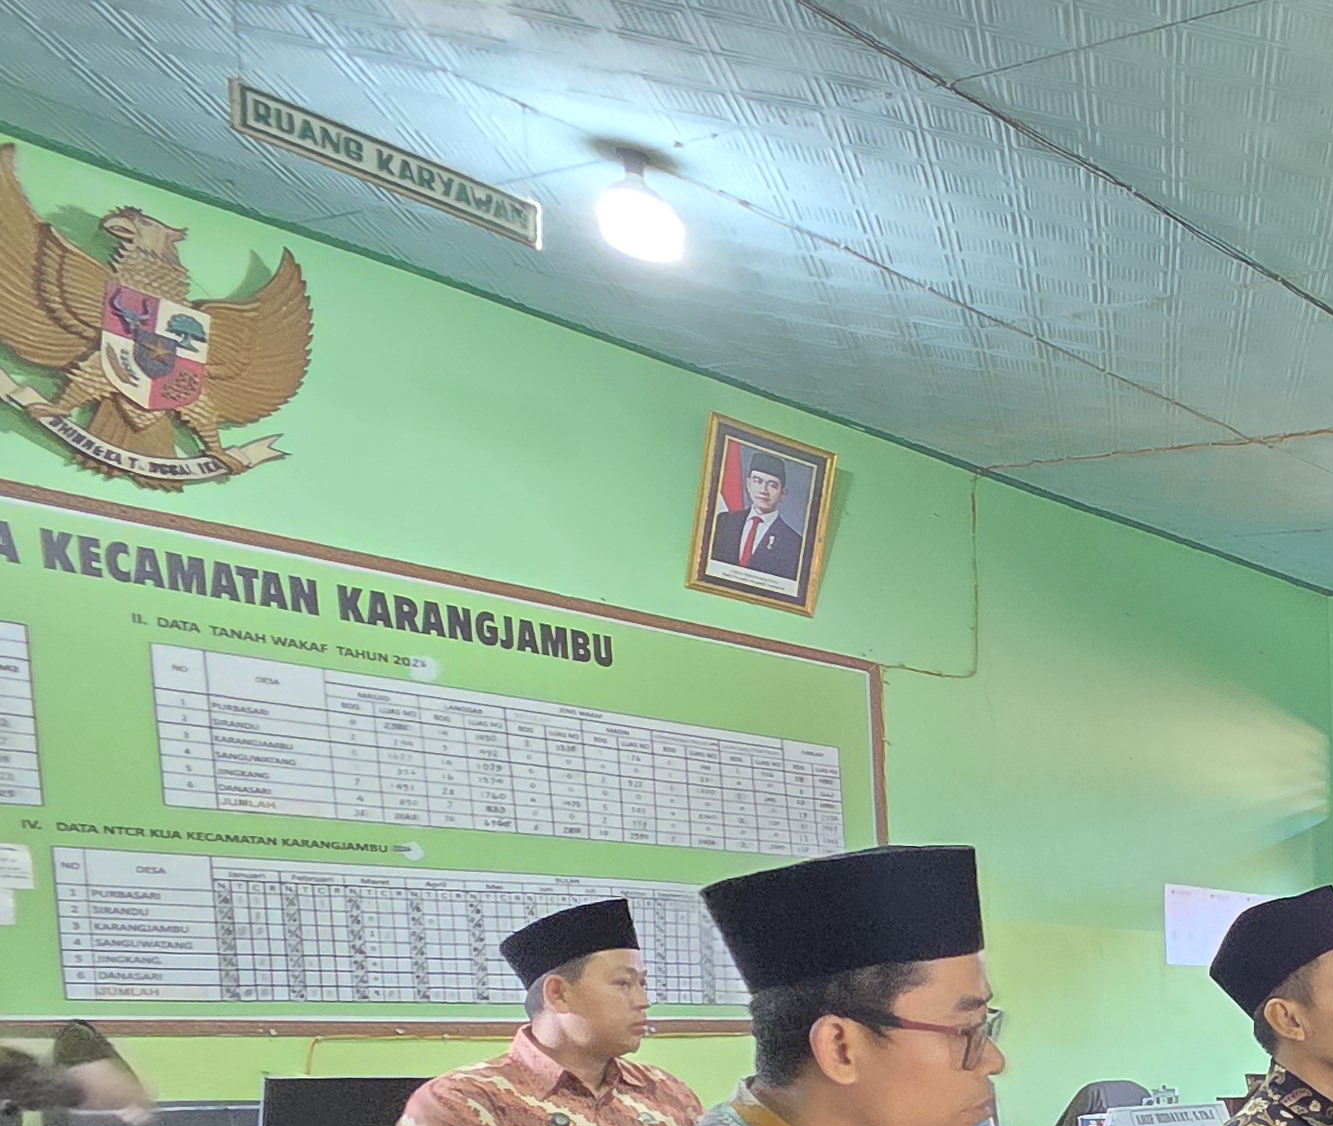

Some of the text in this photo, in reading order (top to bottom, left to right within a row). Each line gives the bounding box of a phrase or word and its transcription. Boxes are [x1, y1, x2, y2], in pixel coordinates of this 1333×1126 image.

[251, 97, 528, 230] RUANG KARYAWAN
[40, 527, 319, 616] KECAMATAN
[336, 584, 613, 667] KARANGJAMBU
[131, 612, 147, 625] II.
[157, 616, 201, 633] DATA
[208, 624, 266, 644] TANAH
[270, 635, 328, 653] WAKAF
[335, 645, 388, 663] TAHUN
[21, 819, 388, 853] IV. DATA NTCR KUA KECAMATAN KARANGJAMBU
